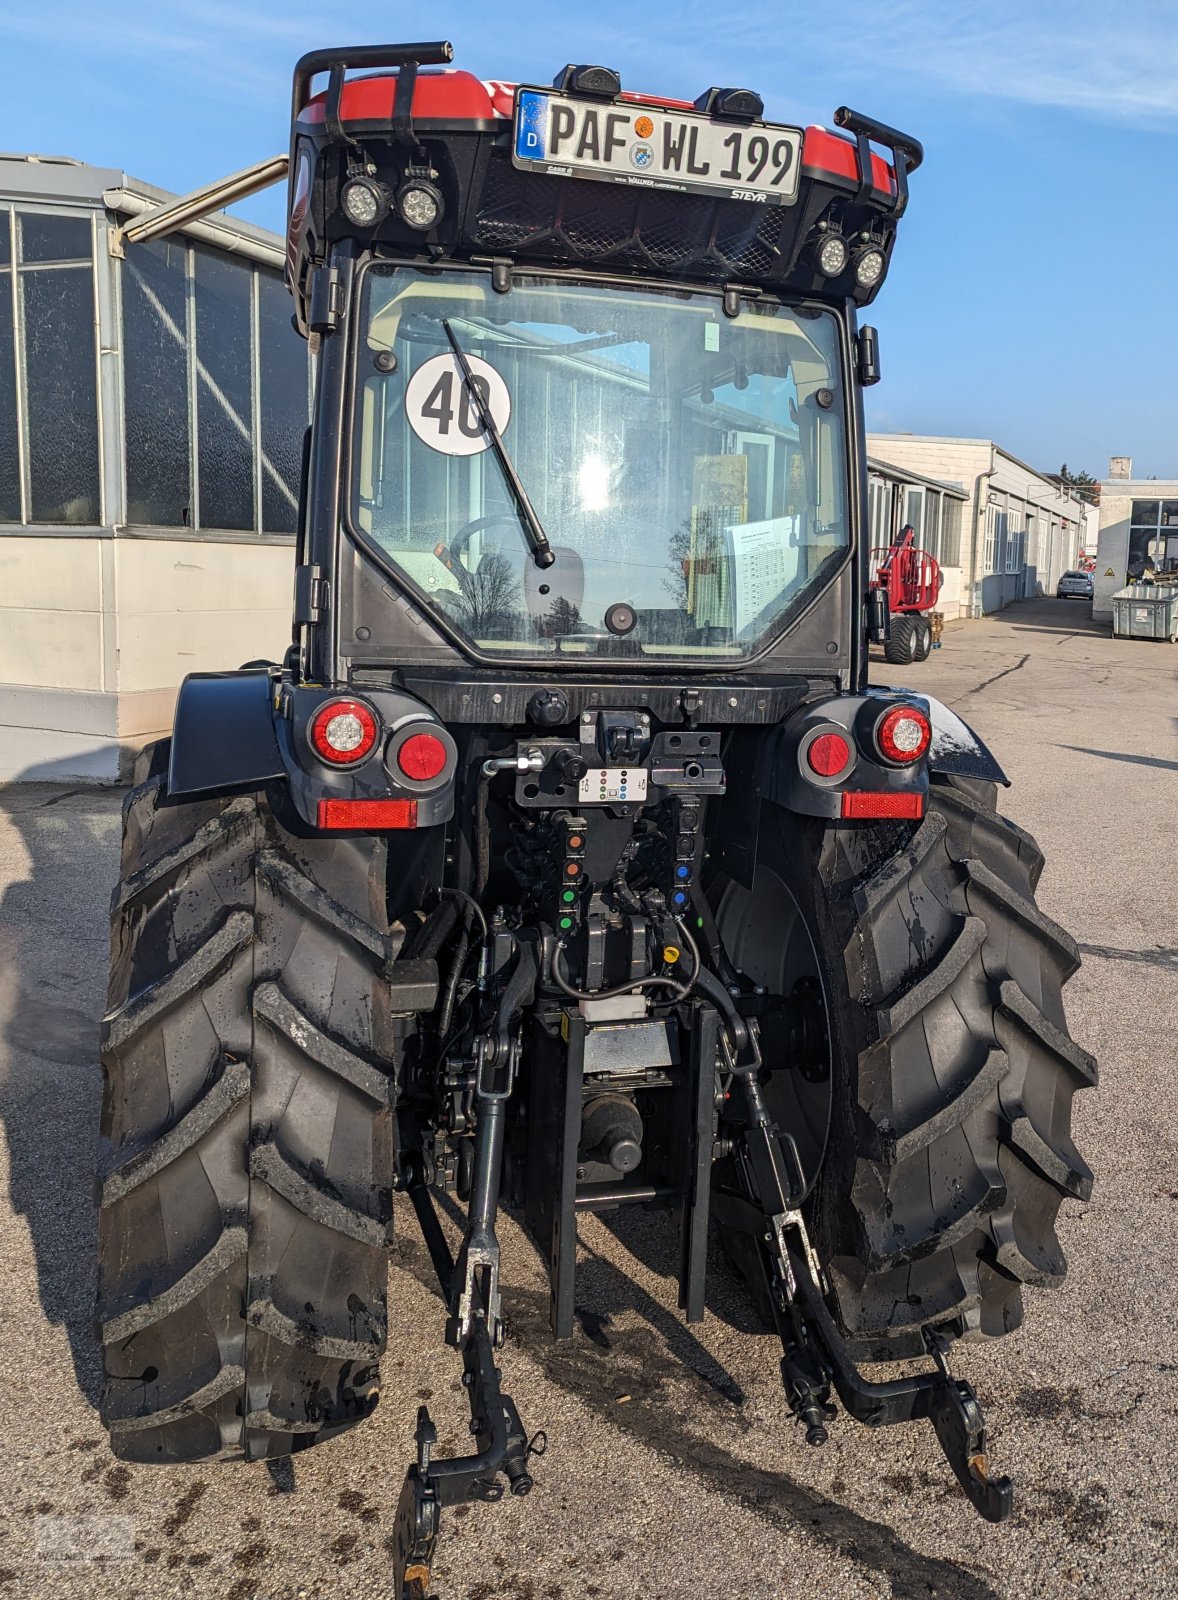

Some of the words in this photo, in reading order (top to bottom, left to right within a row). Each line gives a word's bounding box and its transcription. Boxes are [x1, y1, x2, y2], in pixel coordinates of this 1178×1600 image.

[526, 132, 537, 147] D
[550, 104, 631, 162] PAF
[662, 121, 710, 176] WL
[720, 132, 793, 186] 199
[730, 190, 767, 203] STEYR
[421, 371, 491, 439] 40
